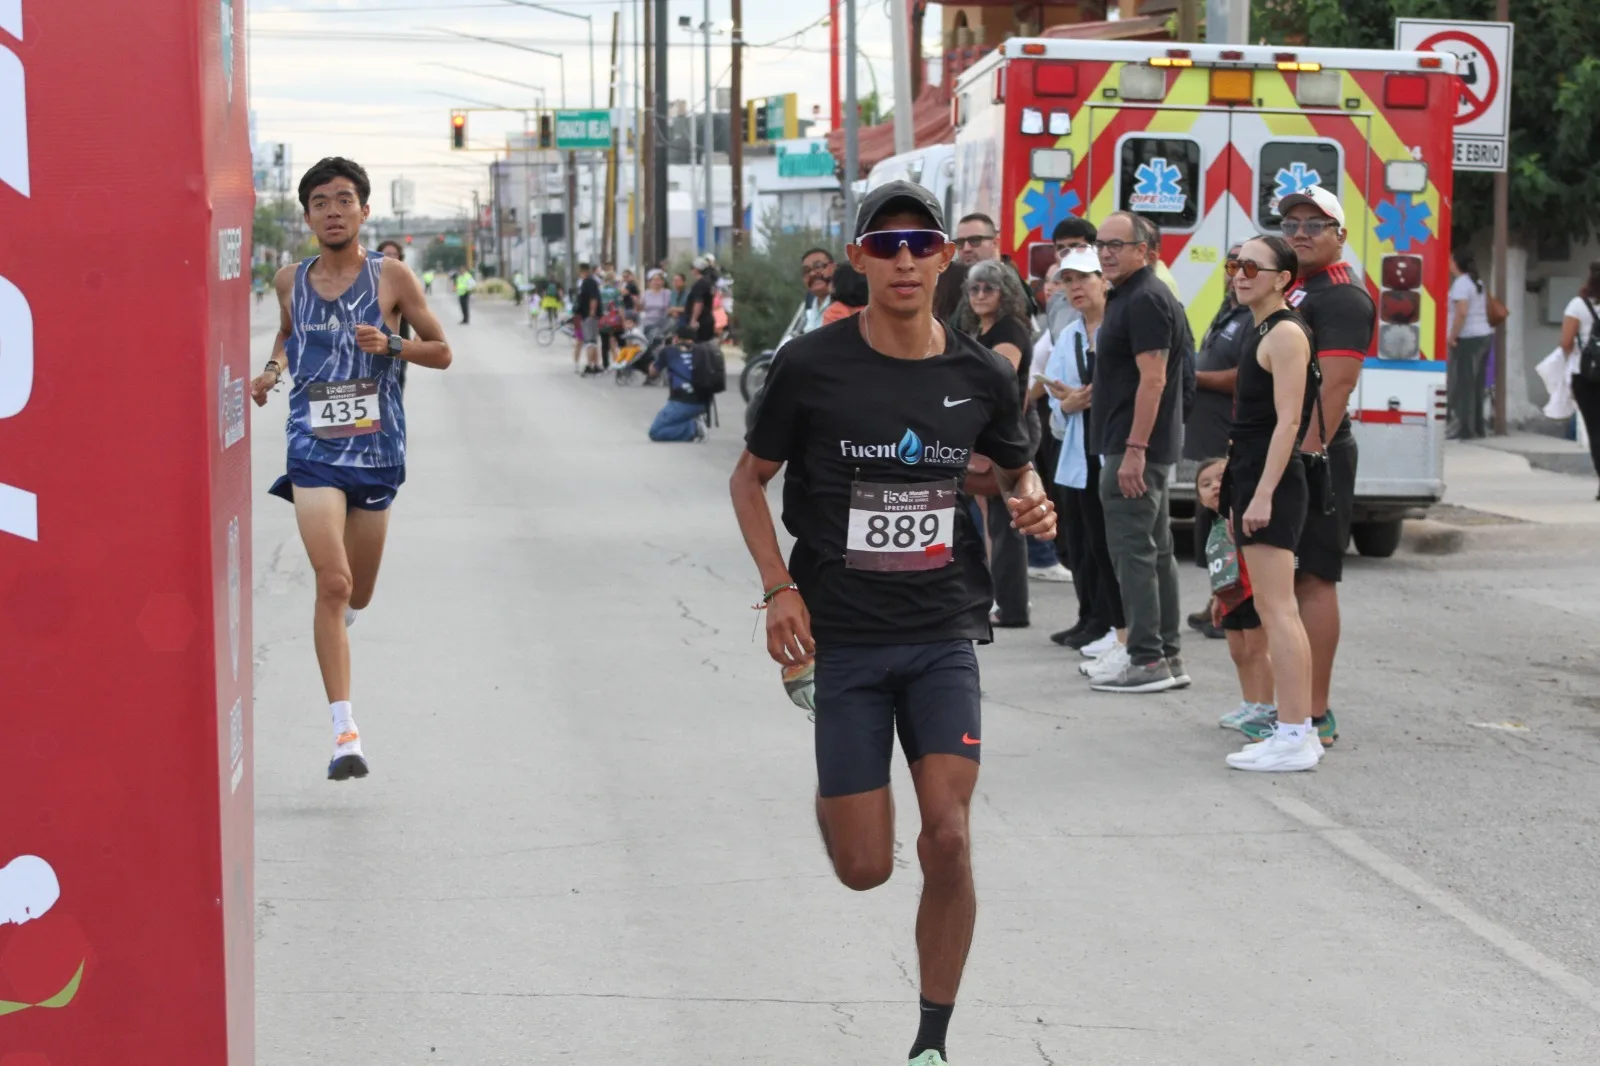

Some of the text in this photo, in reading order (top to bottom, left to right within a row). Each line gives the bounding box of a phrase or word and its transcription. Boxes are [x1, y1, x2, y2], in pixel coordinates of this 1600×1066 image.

[1467, 145, 1499, 163] EBRIO
[321, 398, 368, 423] 435
[866, 513, 939, 548] 889
